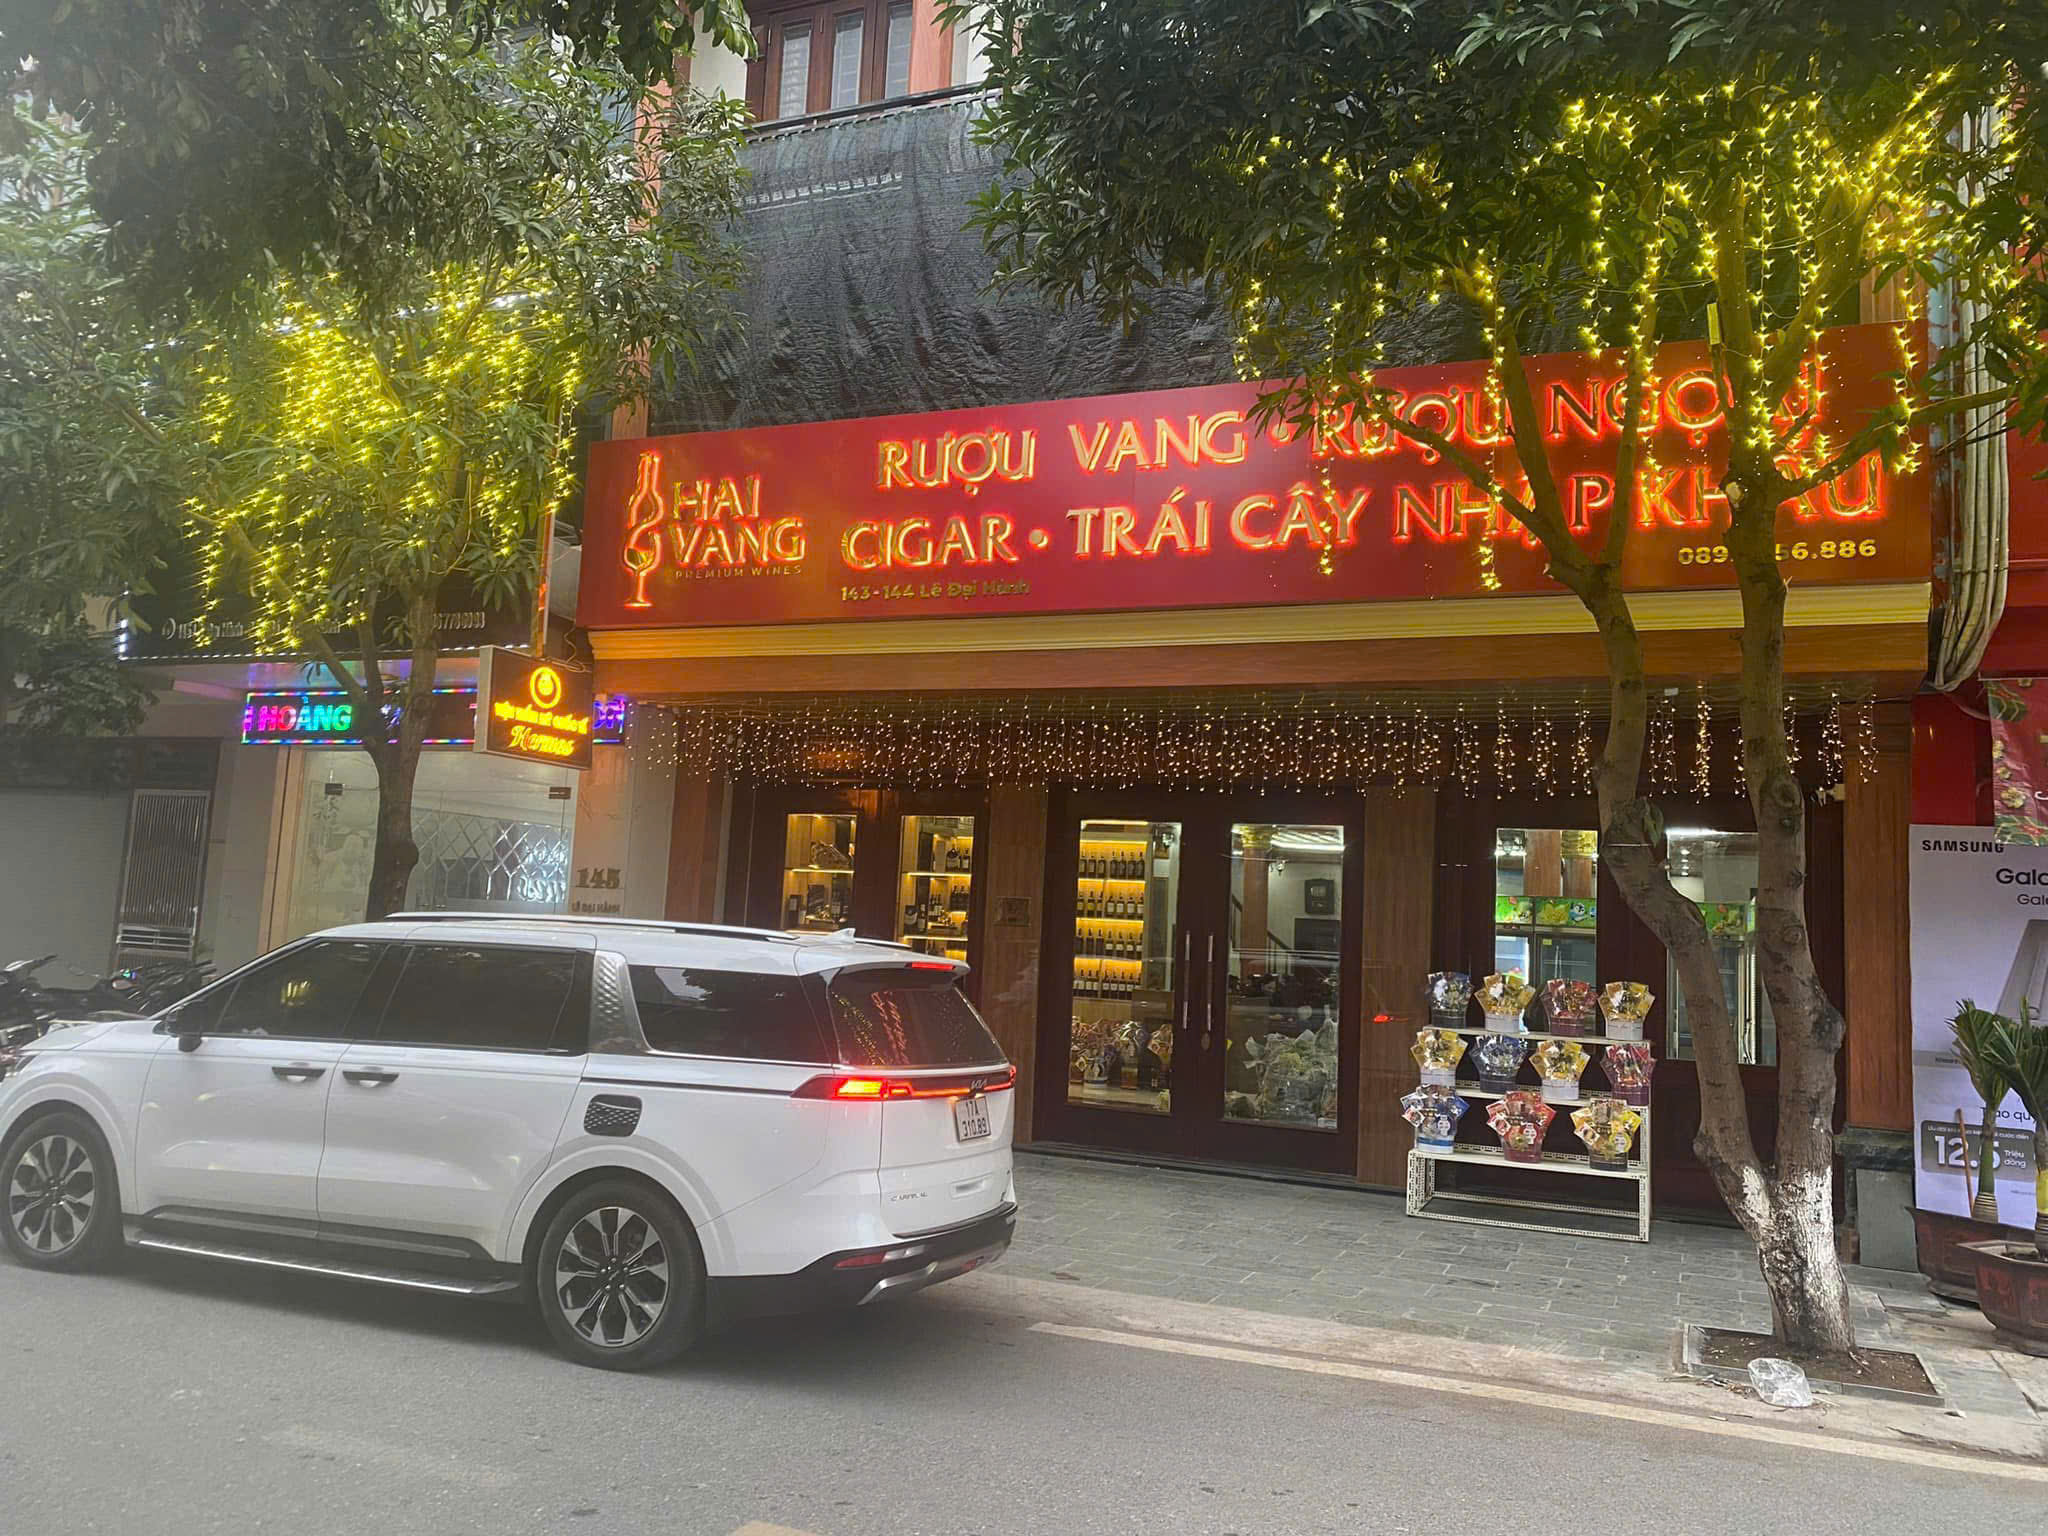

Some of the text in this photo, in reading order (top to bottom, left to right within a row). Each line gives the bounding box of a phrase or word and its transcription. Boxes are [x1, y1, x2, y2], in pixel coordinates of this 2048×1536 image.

[877, 427, 1036, 496] RƯỢU
[1067, 411, 1246, 471] VANG
[669, 517, 807, 566] VANG
[839, 514, 1019, 571] CIGAR
[1065, 487, 1210, 556] TRÁI
[1230, 481, 1371, 548] CÂY
[751, 564, 802, 577] WINES
[1921, 839, 2005, 854] SAMSUNG
[576, 867, 621, 890] 145
